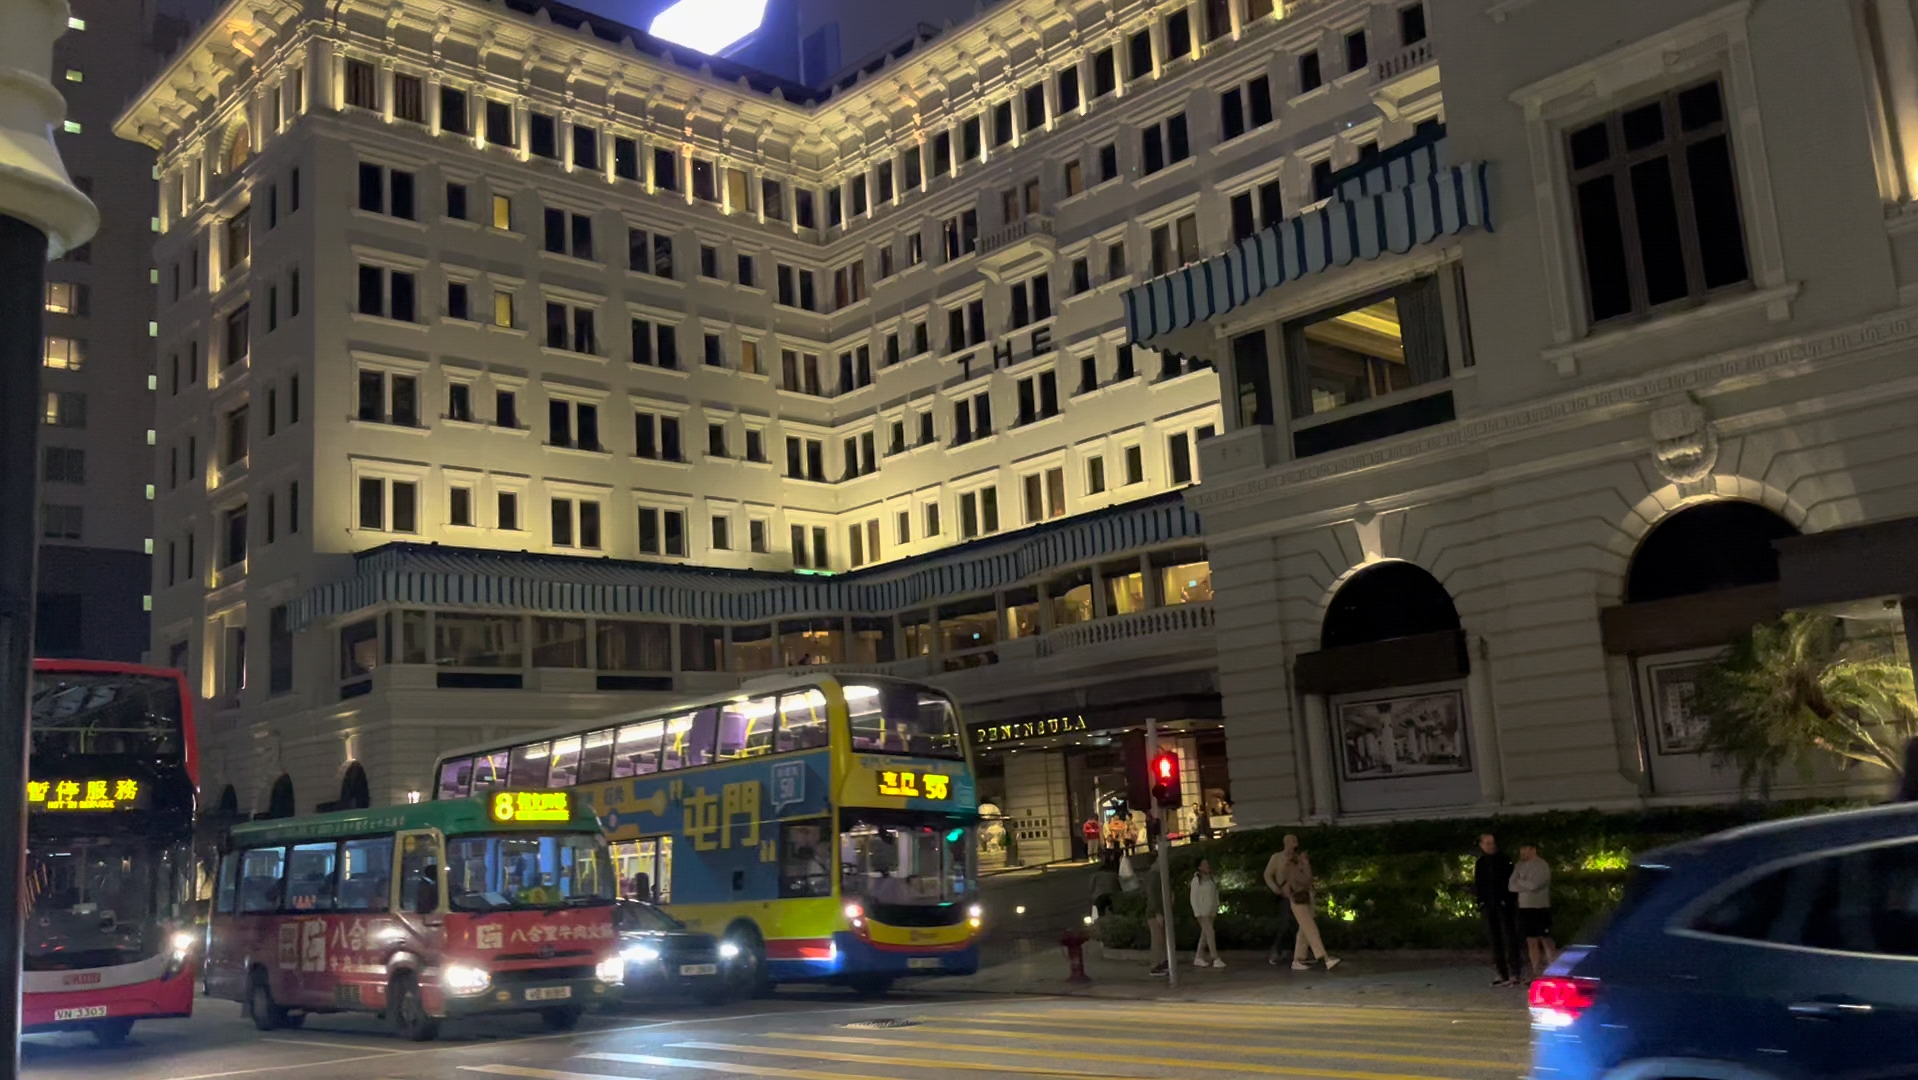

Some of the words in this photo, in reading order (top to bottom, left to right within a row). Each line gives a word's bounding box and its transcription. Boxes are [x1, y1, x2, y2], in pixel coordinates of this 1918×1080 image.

[957, 325, 1052, 381] THE
[977, 714, 1086, 743] PENINSULA
[27, 779, 138, 802] 暫停服務
[495, 792, 514, 821] 8
[683, 780, 761, 852] 屯門
